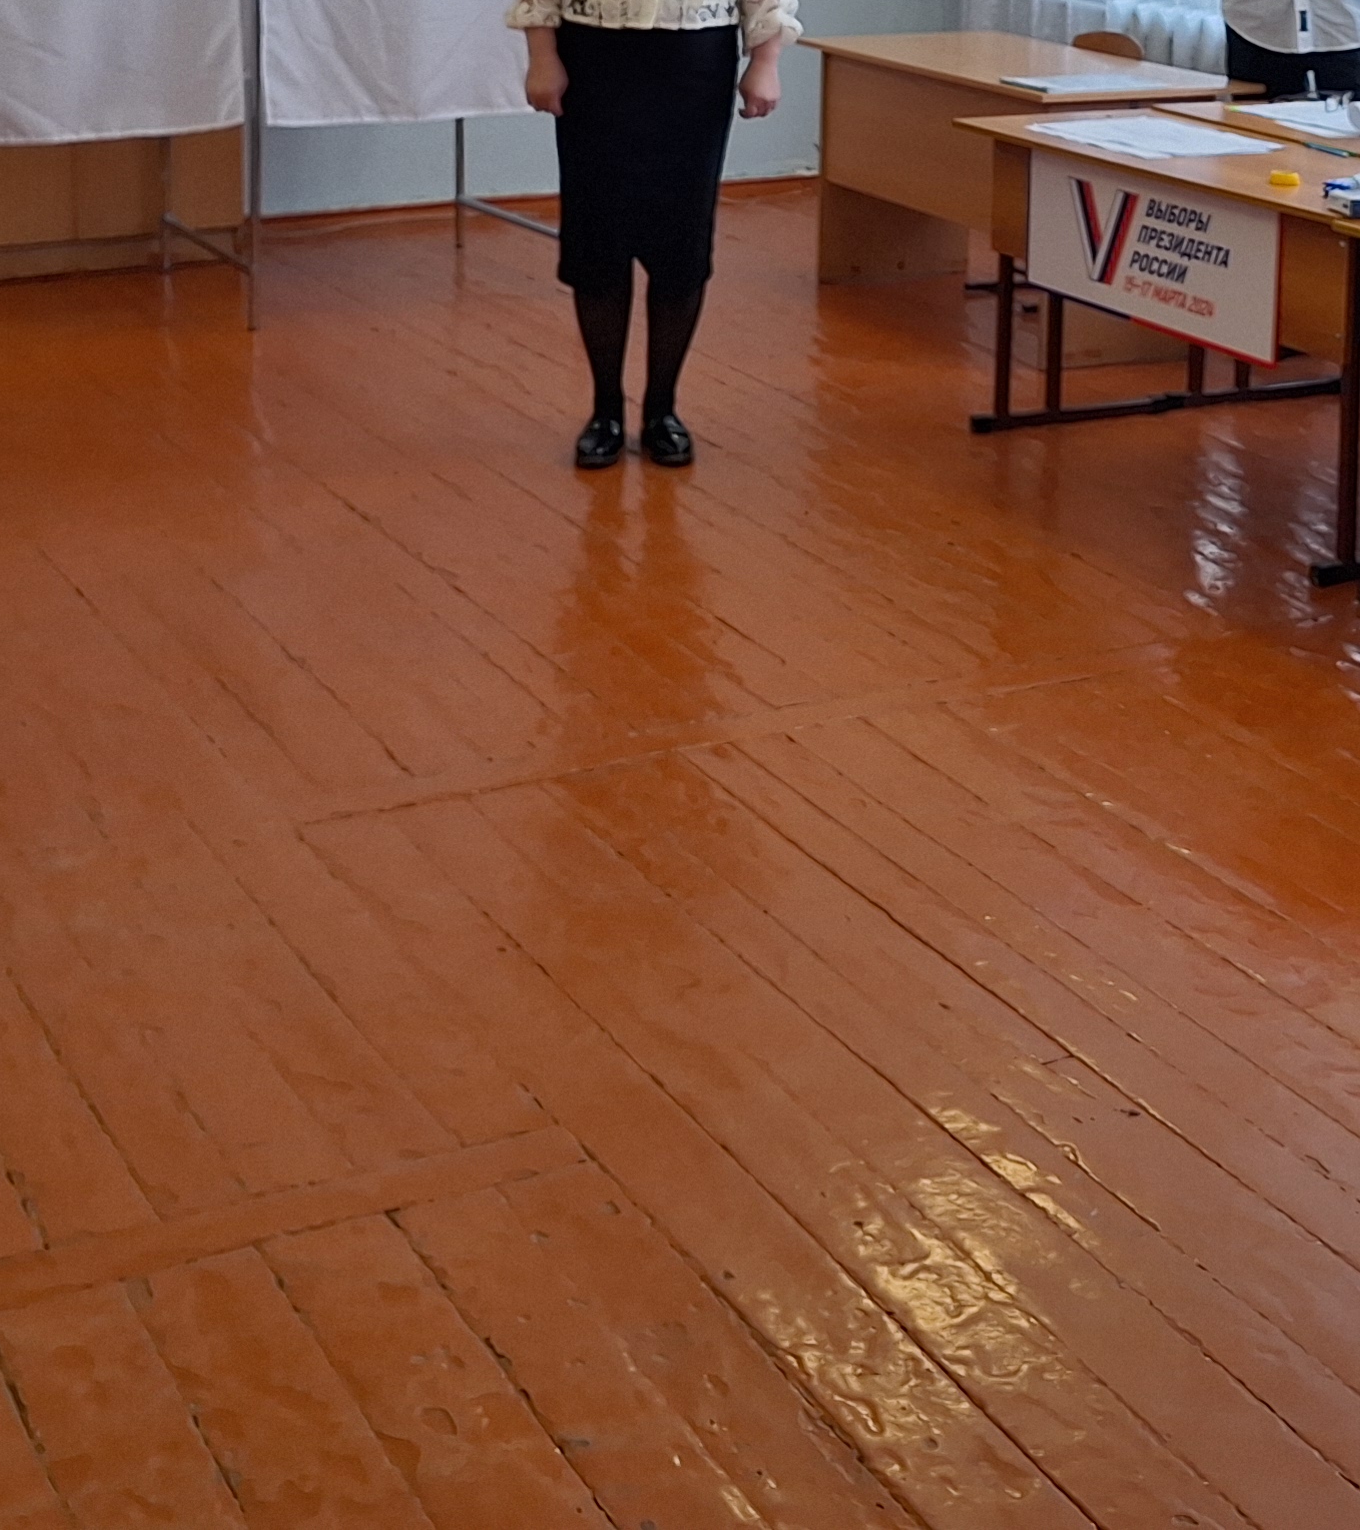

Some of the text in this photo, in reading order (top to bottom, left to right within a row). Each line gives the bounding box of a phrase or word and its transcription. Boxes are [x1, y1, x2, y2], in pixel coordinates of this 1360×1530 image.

[1145, 198, 1212, 234] ВЫБОРЫ
[1137, 224, 1231, 268] ПРЕЗИДЕНТА
[1129, 250, 1189, 284] РОССИИ
